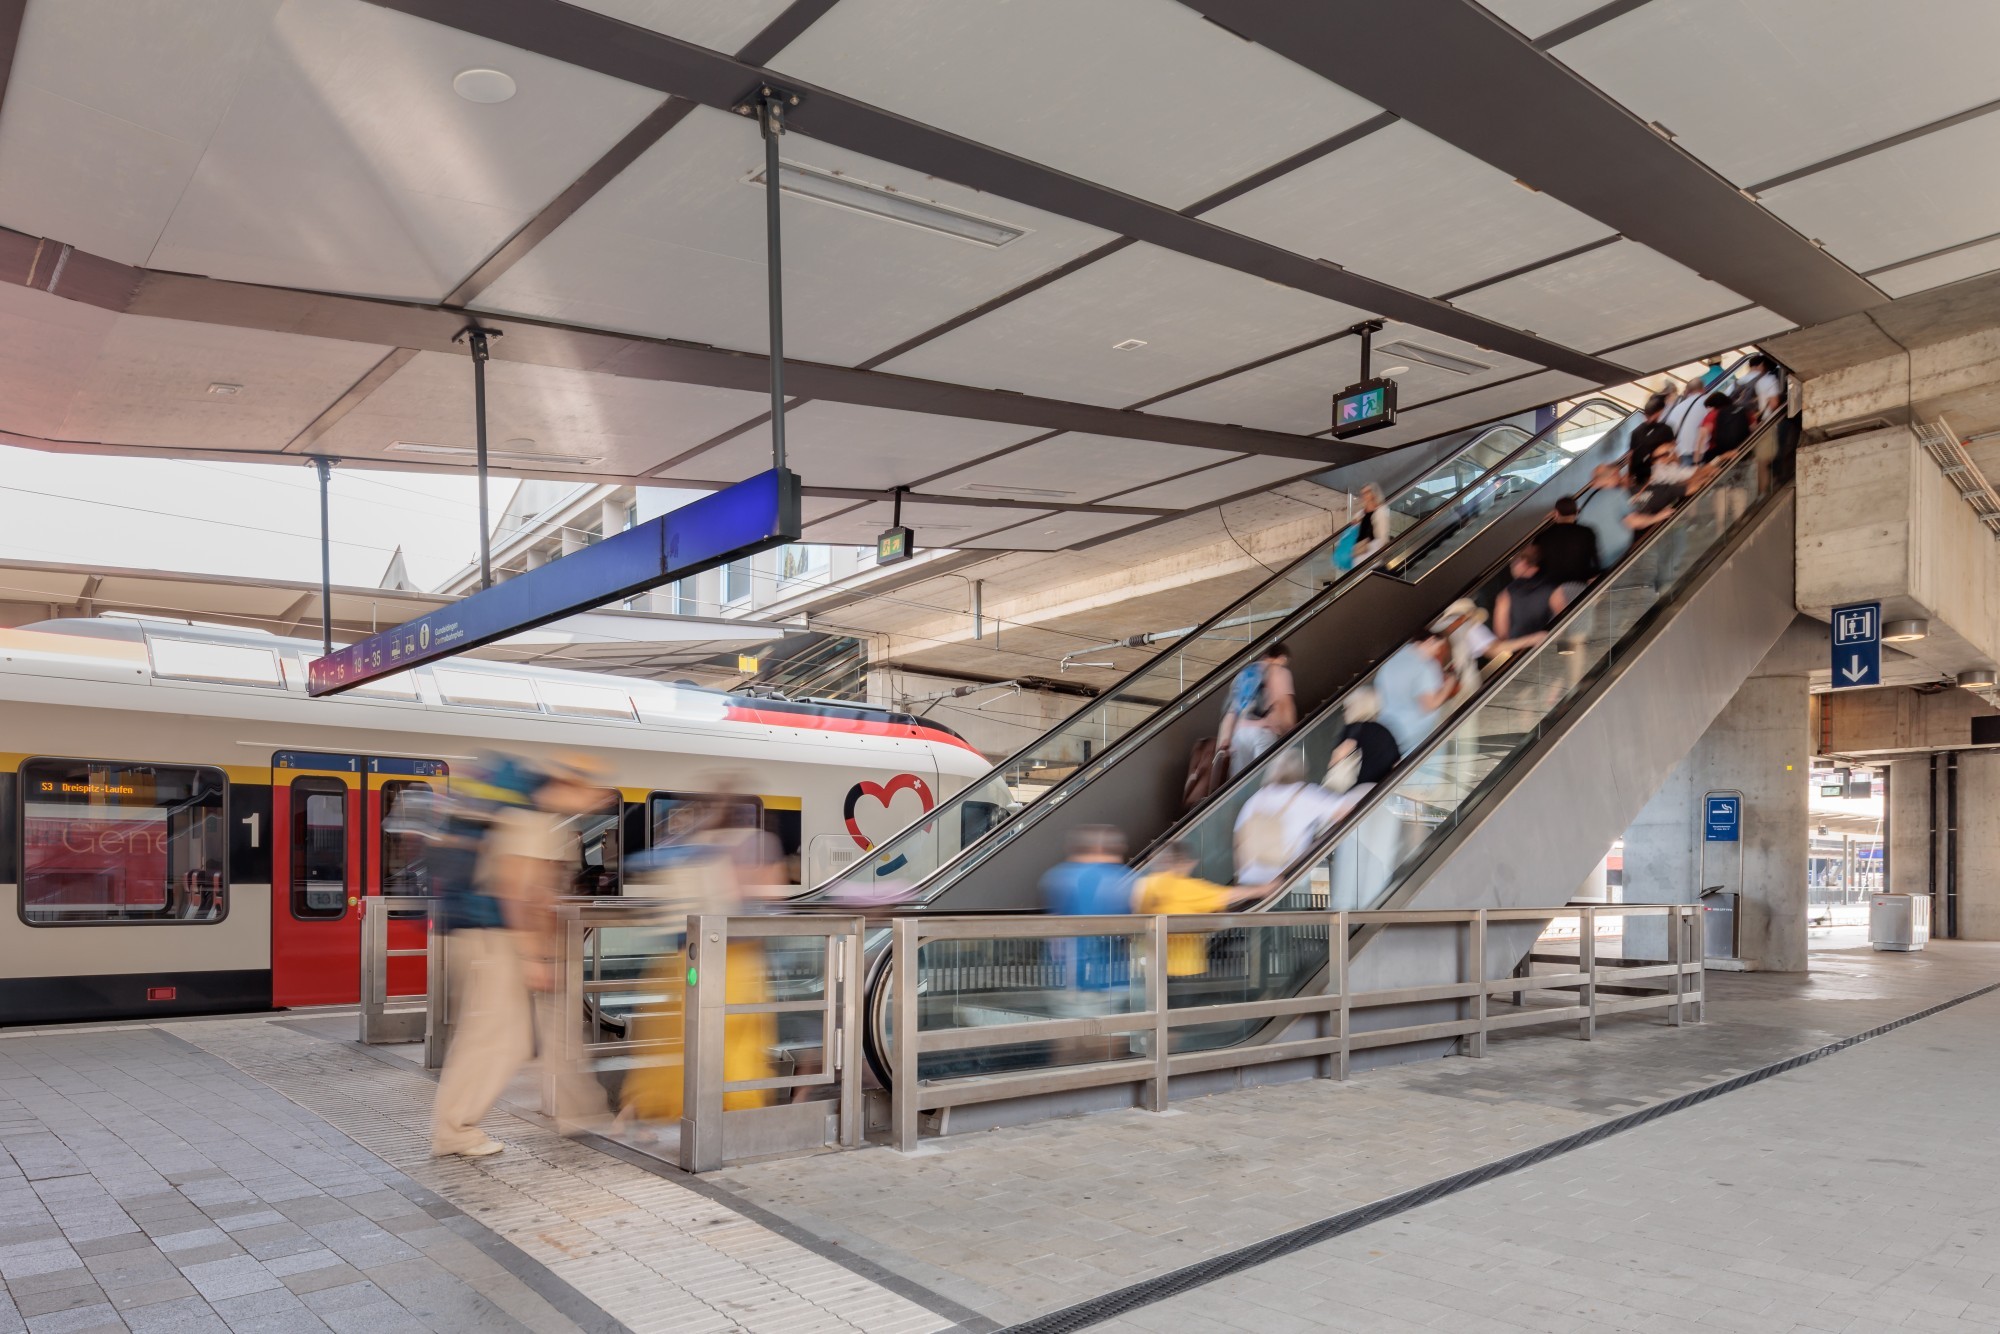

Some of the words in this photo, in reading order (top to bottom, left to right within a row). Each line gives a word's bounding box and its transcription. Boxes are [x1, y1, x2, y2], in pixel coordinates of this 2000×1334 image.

[354, 657, 362, 673] 19
[371, 650, 381, 667] 35
[337, 664, 345, 680] 15
[348, 758, 356, 772] 1
[371, 759, 379, 772] 1
[41, 782, 53, 791] S3
[62, 783, 134, 794] Dreispitz-Laufen
[242, 812, 260, 848] 1
